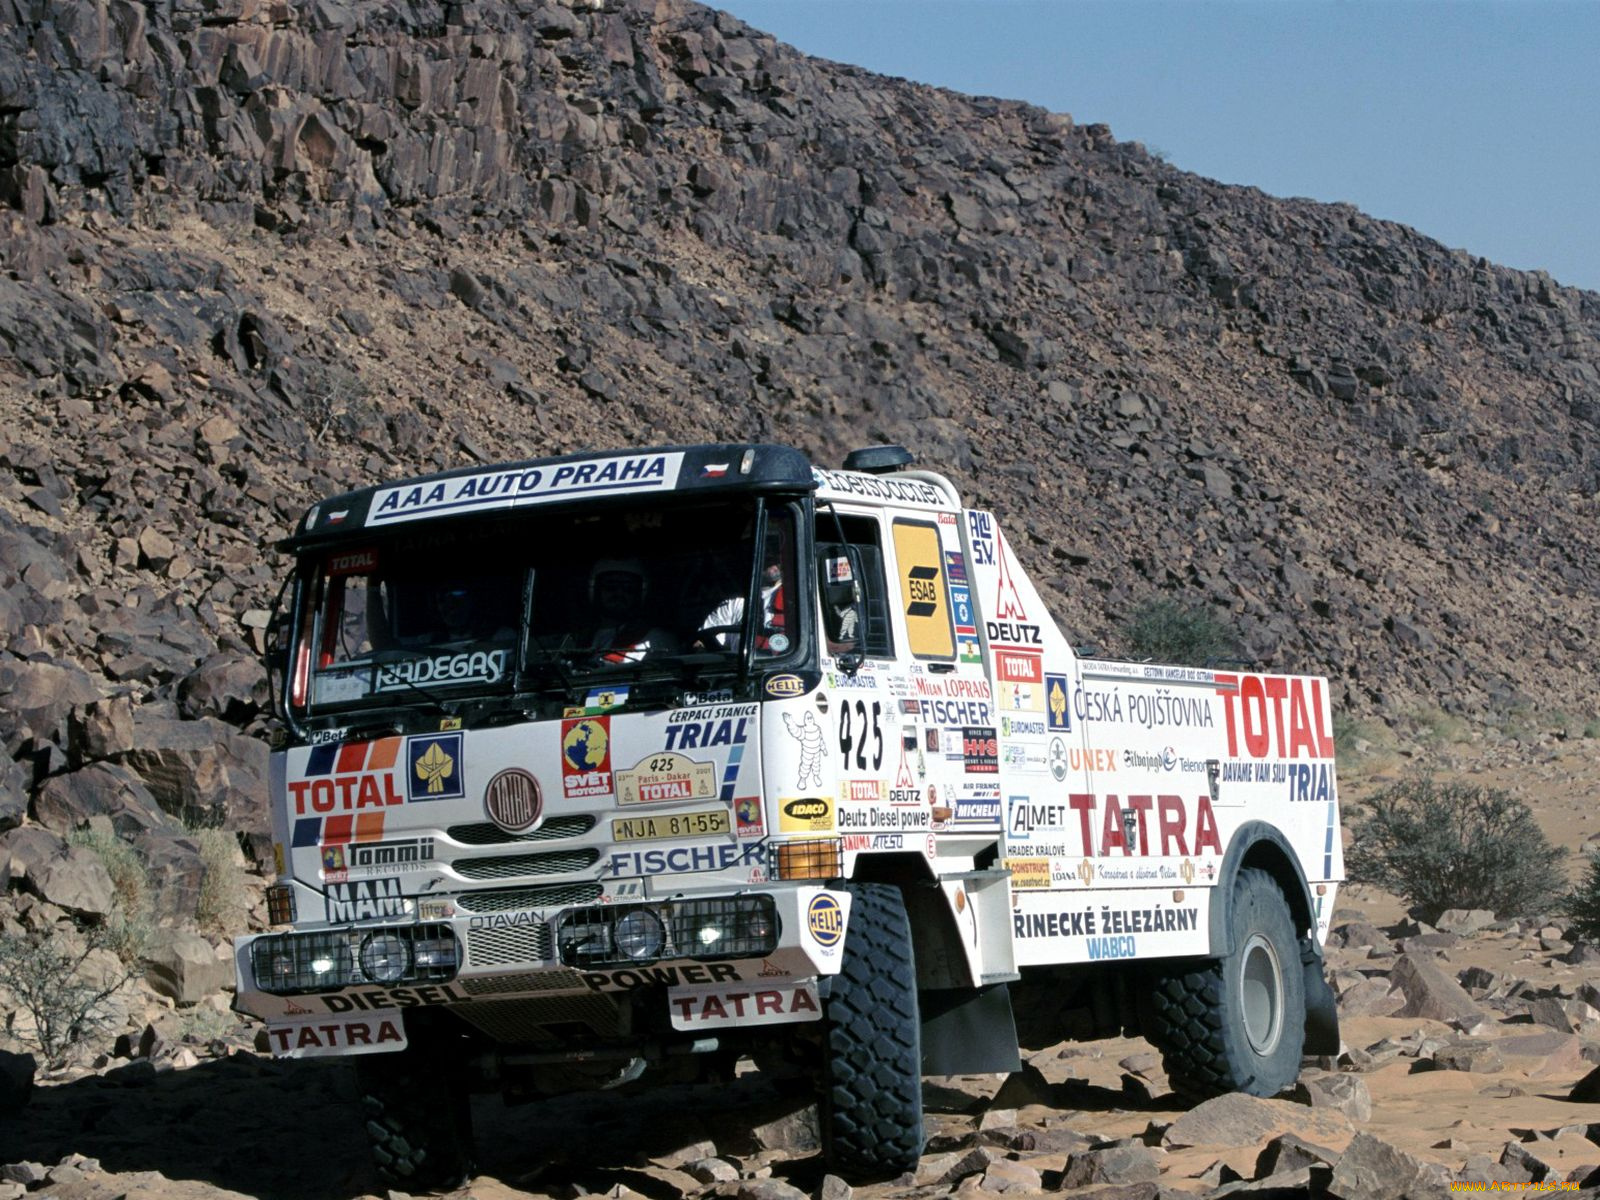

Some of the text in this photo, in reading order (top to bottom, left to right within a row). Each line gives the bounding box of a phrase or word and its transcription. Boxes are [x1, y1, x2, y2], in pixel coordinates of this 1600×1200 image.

[378, 457, 666, 512] AAA AUTO PRAHA
[331, 552, 375, 571] TOTAL
[909, 580, 937, 602] ESAB
[986, 621, 1043, 647] DEUTZ
[1005, 658, 1036, 679] TOTAL
[698, 691, 730, 706] Beta
[944, 678, 991, 699] LOPRAIS
[668, 704, 759, 724] ČERPACÍ STANICE
[920, 700, 991, 726] FISCHER
[1073, 680, 1214, 729] ČESKÁ POJIŠŤOVNA
[1214, 673, 1335, 759] TOTAL
[664, 717, 749, 751] TRIAL
[839, 698, 883, 772] 425
[1010, 720, 1046, 735] EUROMASTER
[650, 758, 674, 772] 425
[1069, 748, 1118, 773] UNEX
[565, 771, 611, 788] SVĚT
[638, 774, 659, 784] Paris
[666, 772, 691, 782] Dakar
[963, 782, 974, 790] AIR
[1288, 763, 1336, 803] TRIAL
[288, 773, 404, 815] TOTAL
[641, 781, 691, 800] TOTAL
[851, 781, 879, 800] TOTAL
[890, 789, 921, 802] DEUTZ
[792, 803, 825, 815] IDACO
[838, 807, 868, 827] Deutz
[870, 804, 900, 827] Diesel
[902, 809, 930, 830] power
[1014, 804, 1066, 832] ALMET
[623, 812, 722, 839] NJA 81-55
[1068, 793, 1224, 857] TATRA
[612, 842, 767, 876] FISCHER
[1007, 843, 1066, 857] HRADEC KRÁLOVÉ
[367, 861, 428, 876] RECORDS
[1011, 862, 1050, 874] CONSTRUCT
[470, 911, 545, 928] OTAVAN
[810, 910, 843, 933] HELLA
[1101, 903, 1198, 935] ŽELEZÁRNY
[1086, 936, 1137, 960] WABCO
[321, 963, 742, 1014] DIESEL POWER
[672, 987, 818, 1022] TATRA
[269, 1020, 405, 1052] TATRA
